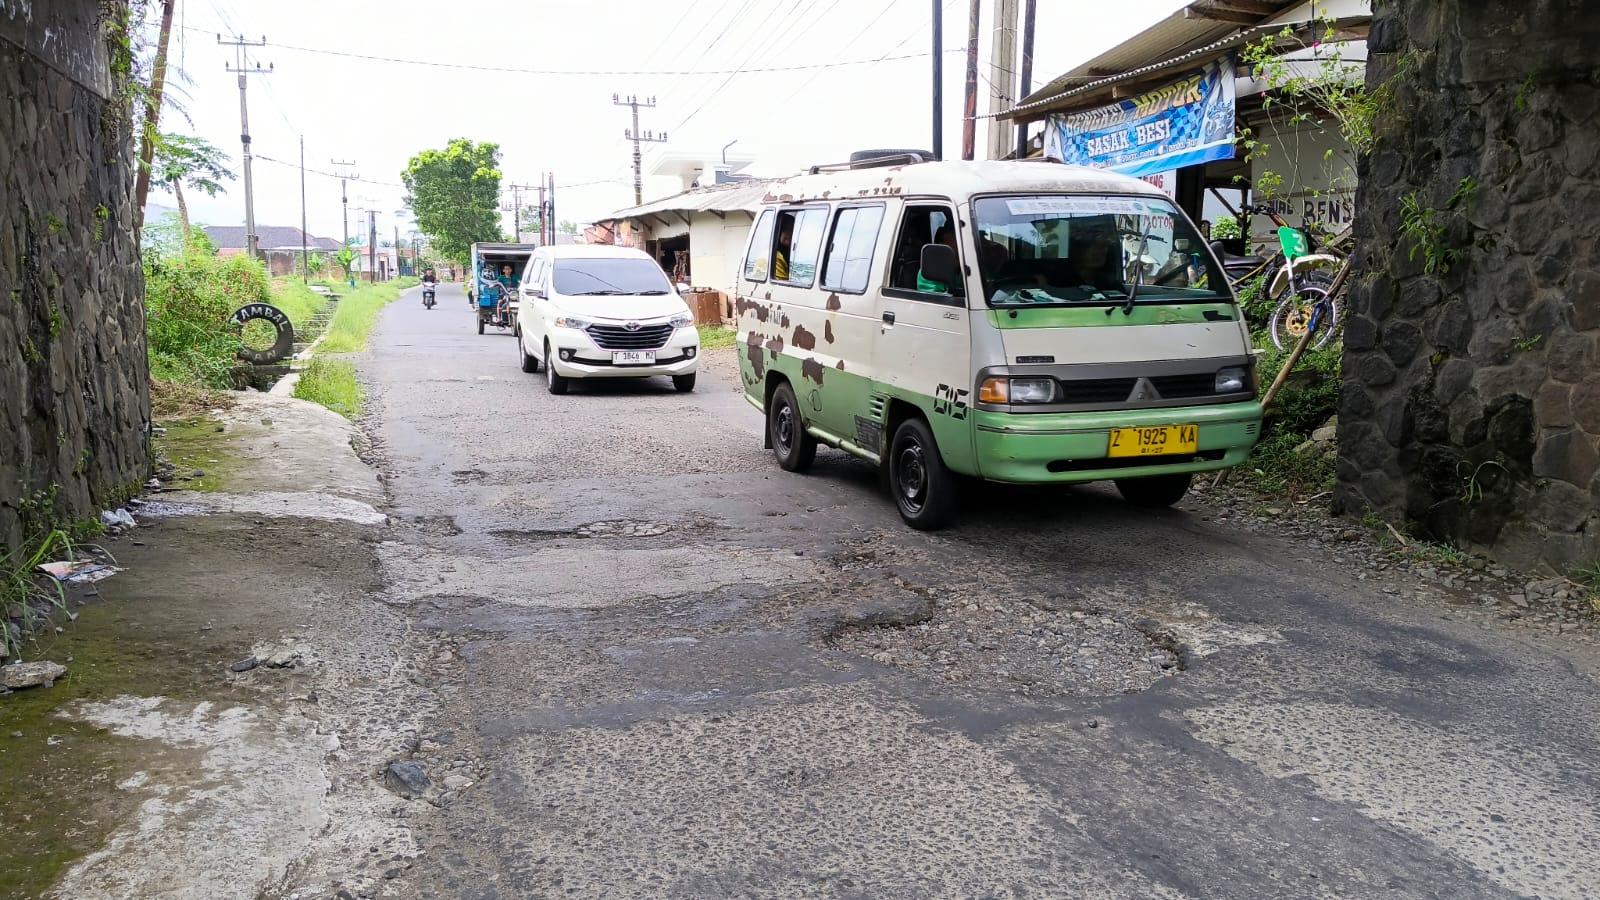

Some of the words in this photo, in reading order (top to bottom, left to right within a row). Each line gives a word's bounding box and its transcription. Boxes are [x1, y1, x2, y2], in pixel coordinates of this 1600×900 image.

[1087, 130, 1130, 157] SASAK
[1136, 119, 1172, 146] BESI
[1112, 430, 1121, 447] Z
[1137, 428, 1168, 446] 1925
[1180, 426, 1195, 443] KA
